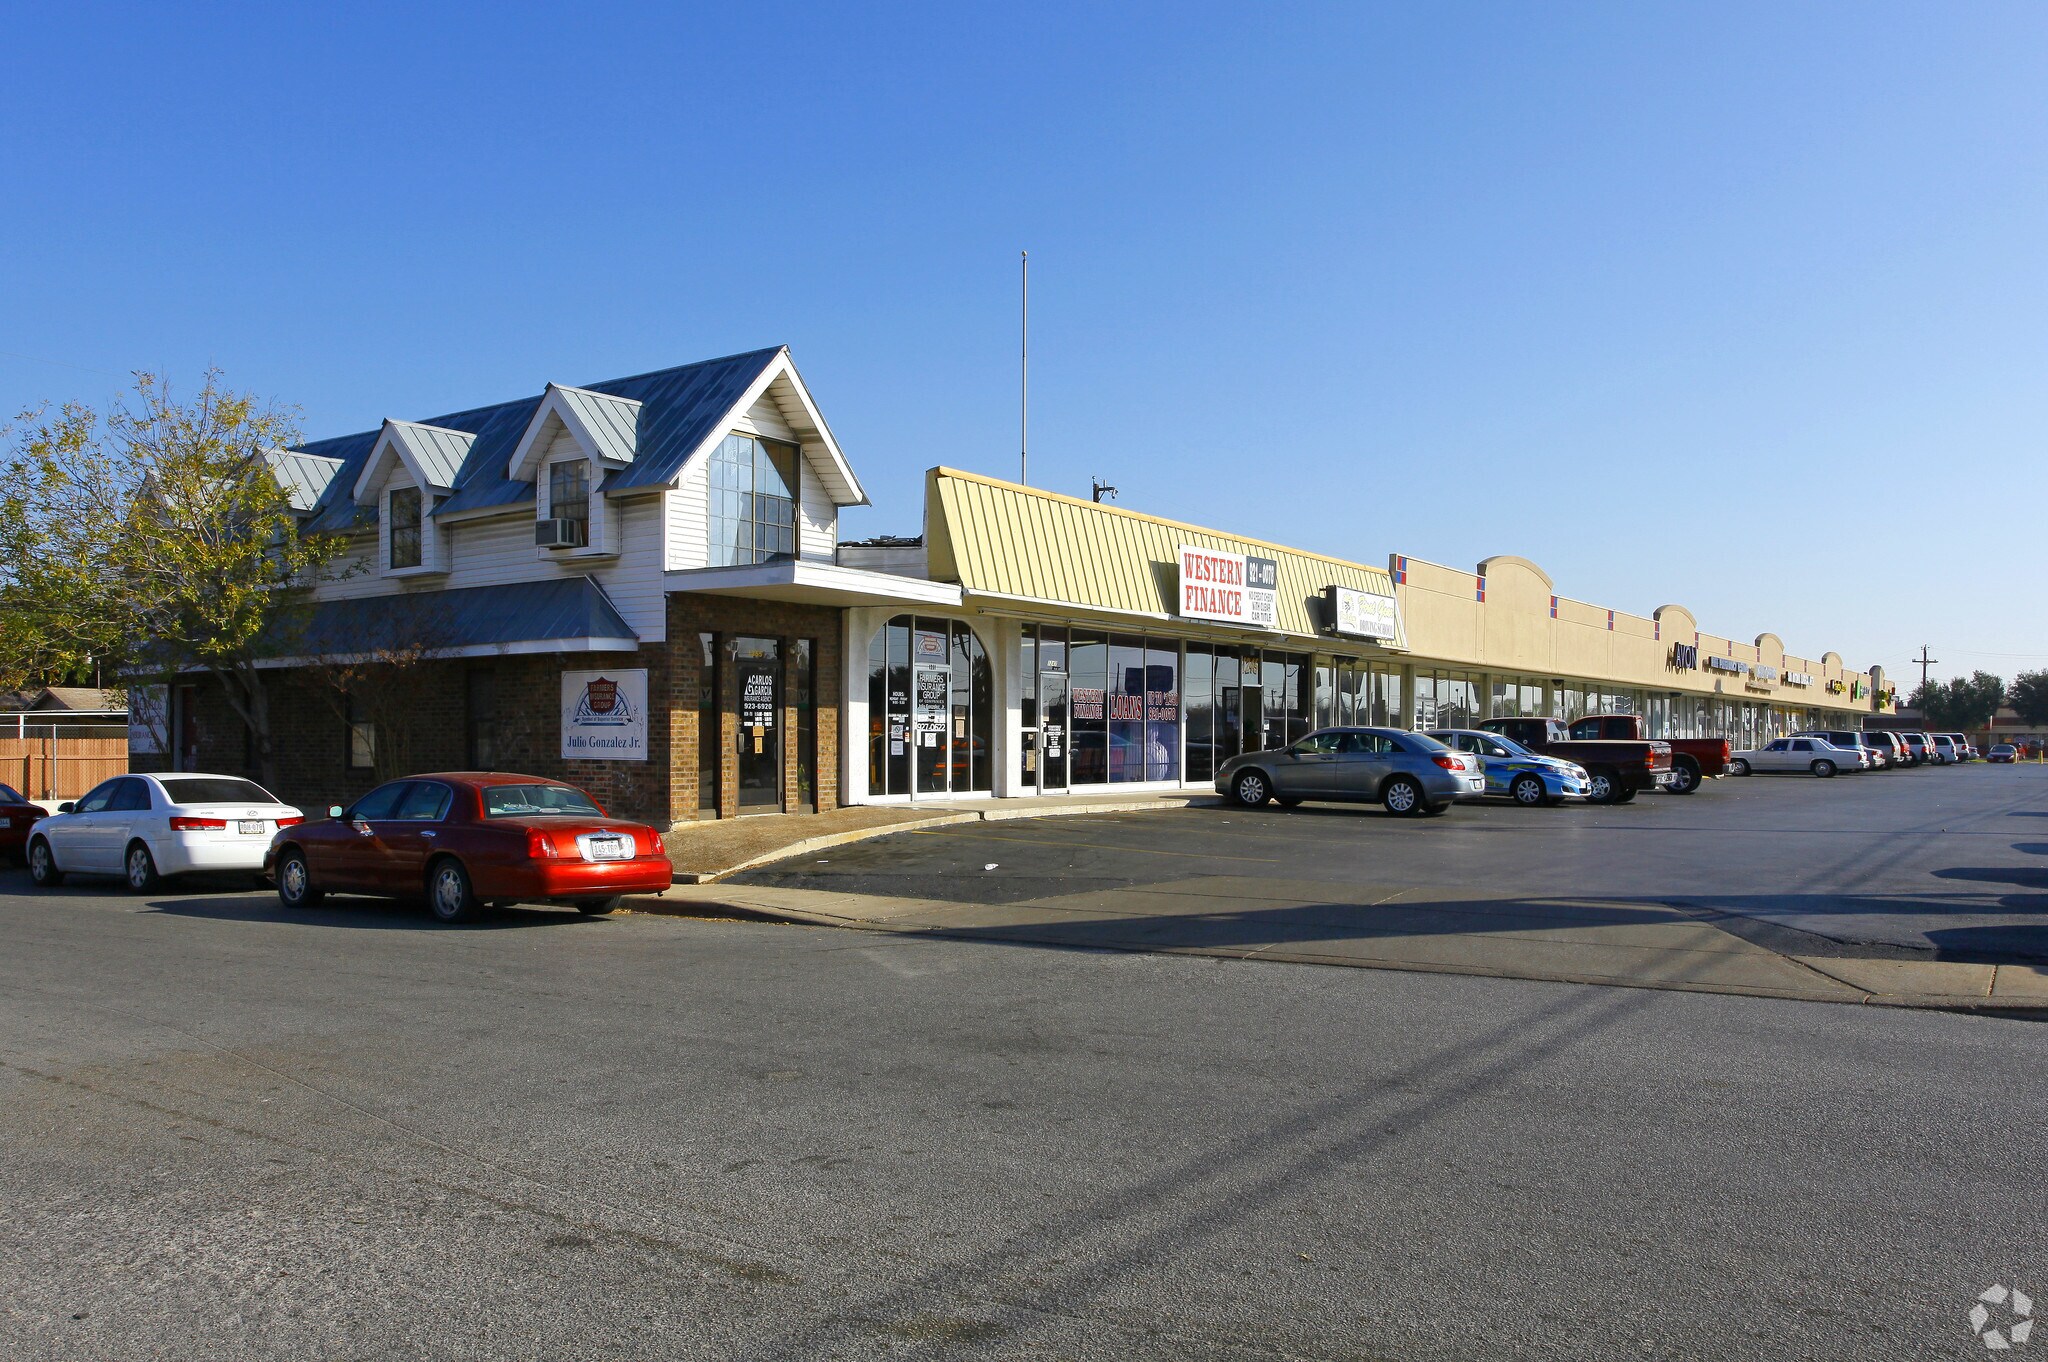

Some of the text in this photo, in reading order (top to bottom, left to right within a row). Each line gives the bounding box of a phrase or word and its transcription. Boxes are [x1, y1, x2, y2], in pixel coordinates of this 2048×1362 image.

[1184, 553, 1243, 586] WESTERN
[1185, 585, 1242, 616] FINANCE
[1251, 611, 1272, 622] CAR TITLE
[1360, 620, 1394, 636] DRIVING SCHOOL
[1675, 643, 1697, 670] AVON
[752, 675, 773, 685] CARLOS
[920, 673, 944, 683] FARMERS
[590, 684, 614, 692] FARMERS
[755, 685, 773, 695] GARCIA
[917, 682, 946, 691] INSURANCE
[922, 691, 941, 700] GROUP
[1073, 688, 1104, 703] WESTERN
[1147, 691, 1154, 706] UP
[1155, 691, 1163, 706] TO
[1074, 704, 1102, 720] FINANCE
[1111, 695, 1142, 720] LOANS
[567, 735, 640, 749] Julio Gonzalez Jr.
